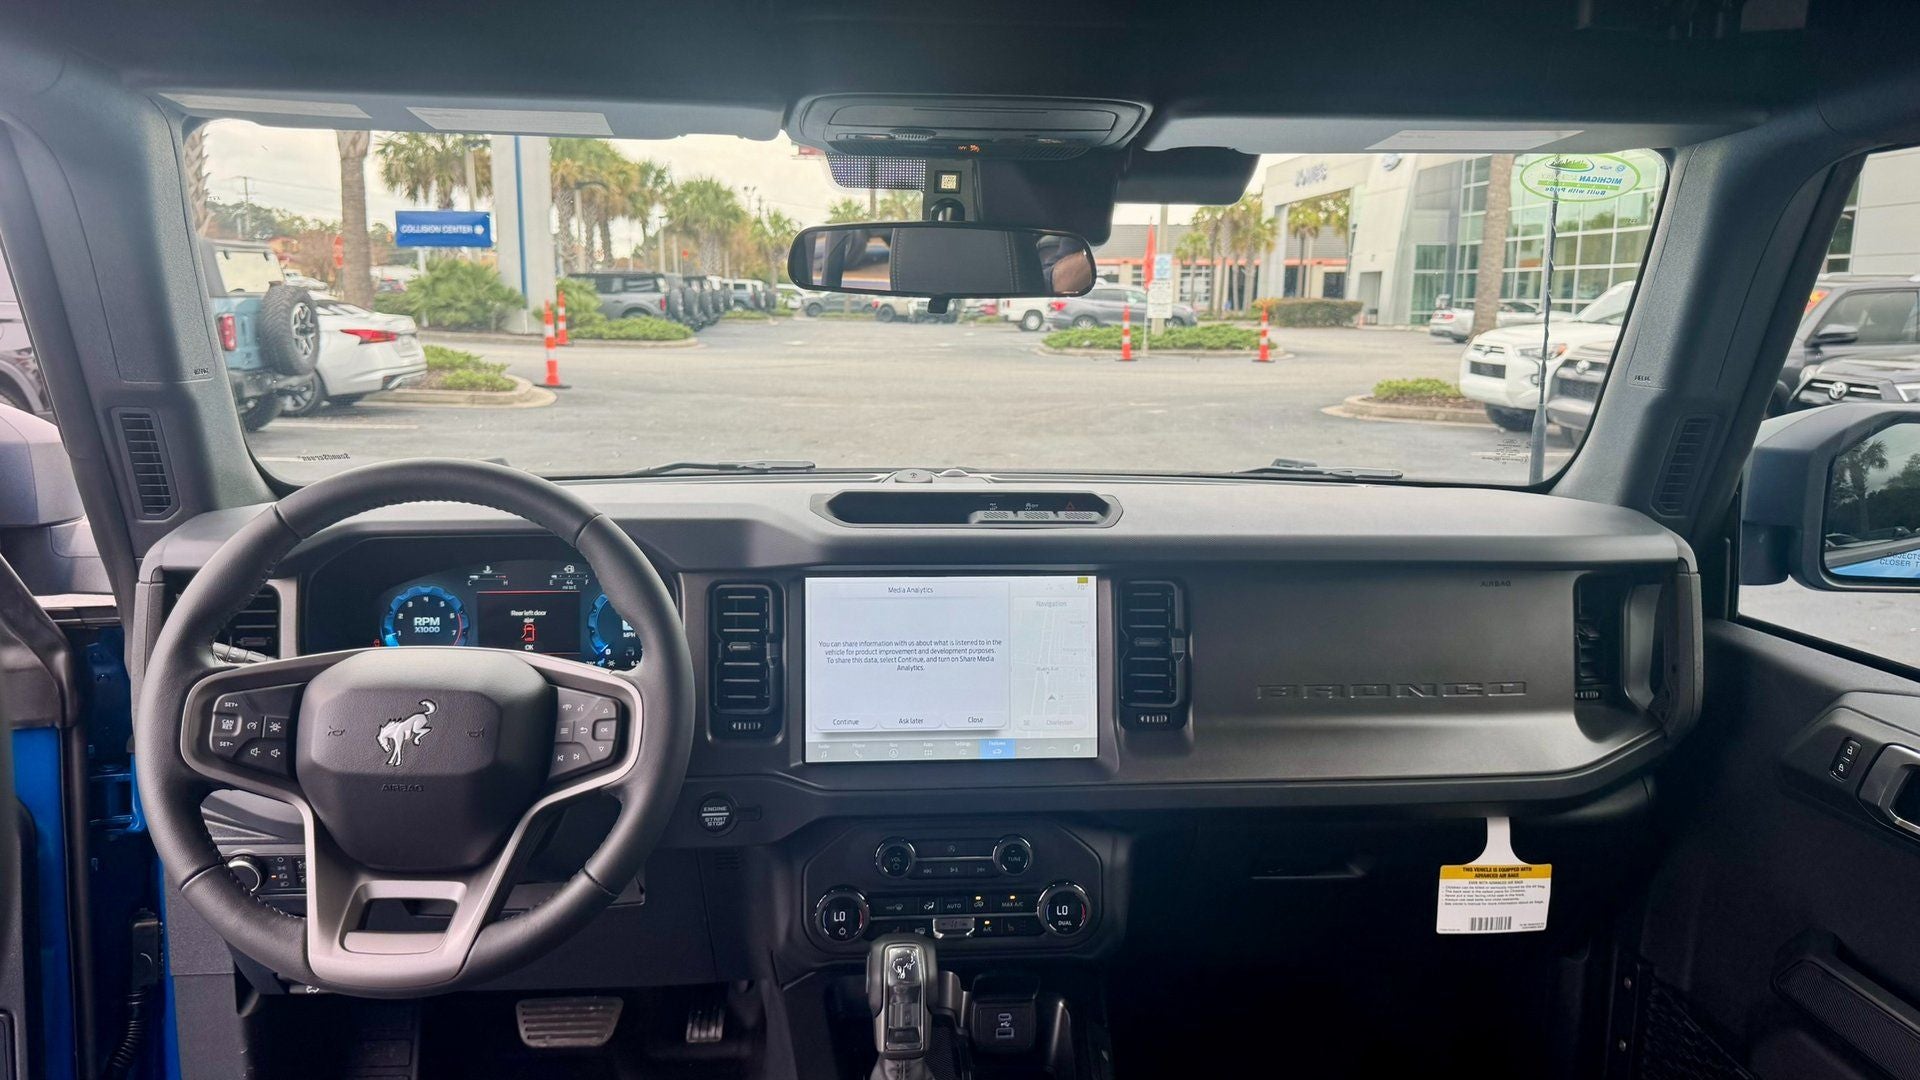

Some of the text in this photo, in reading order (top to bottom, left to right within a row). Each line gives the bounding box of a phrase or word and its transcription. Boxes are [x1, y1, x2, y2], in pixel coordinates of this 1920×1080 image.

[400, 224, 473, 234] COLLISION CENTER
[1880, 558, 1911, 567] CLOSER
[887, 586, 934, 594] Media Analytics
[413, 616, 440, 626] RPM
[855, 648, 877, 656] product
[878, 648, 917, 656] improvement
[1257, 681, 1528, 700] BRONCO
[832, 718, 860, 726] Continue
[1056, 905, 1069, 916] LO
[833, 911, 846, 922] LO
